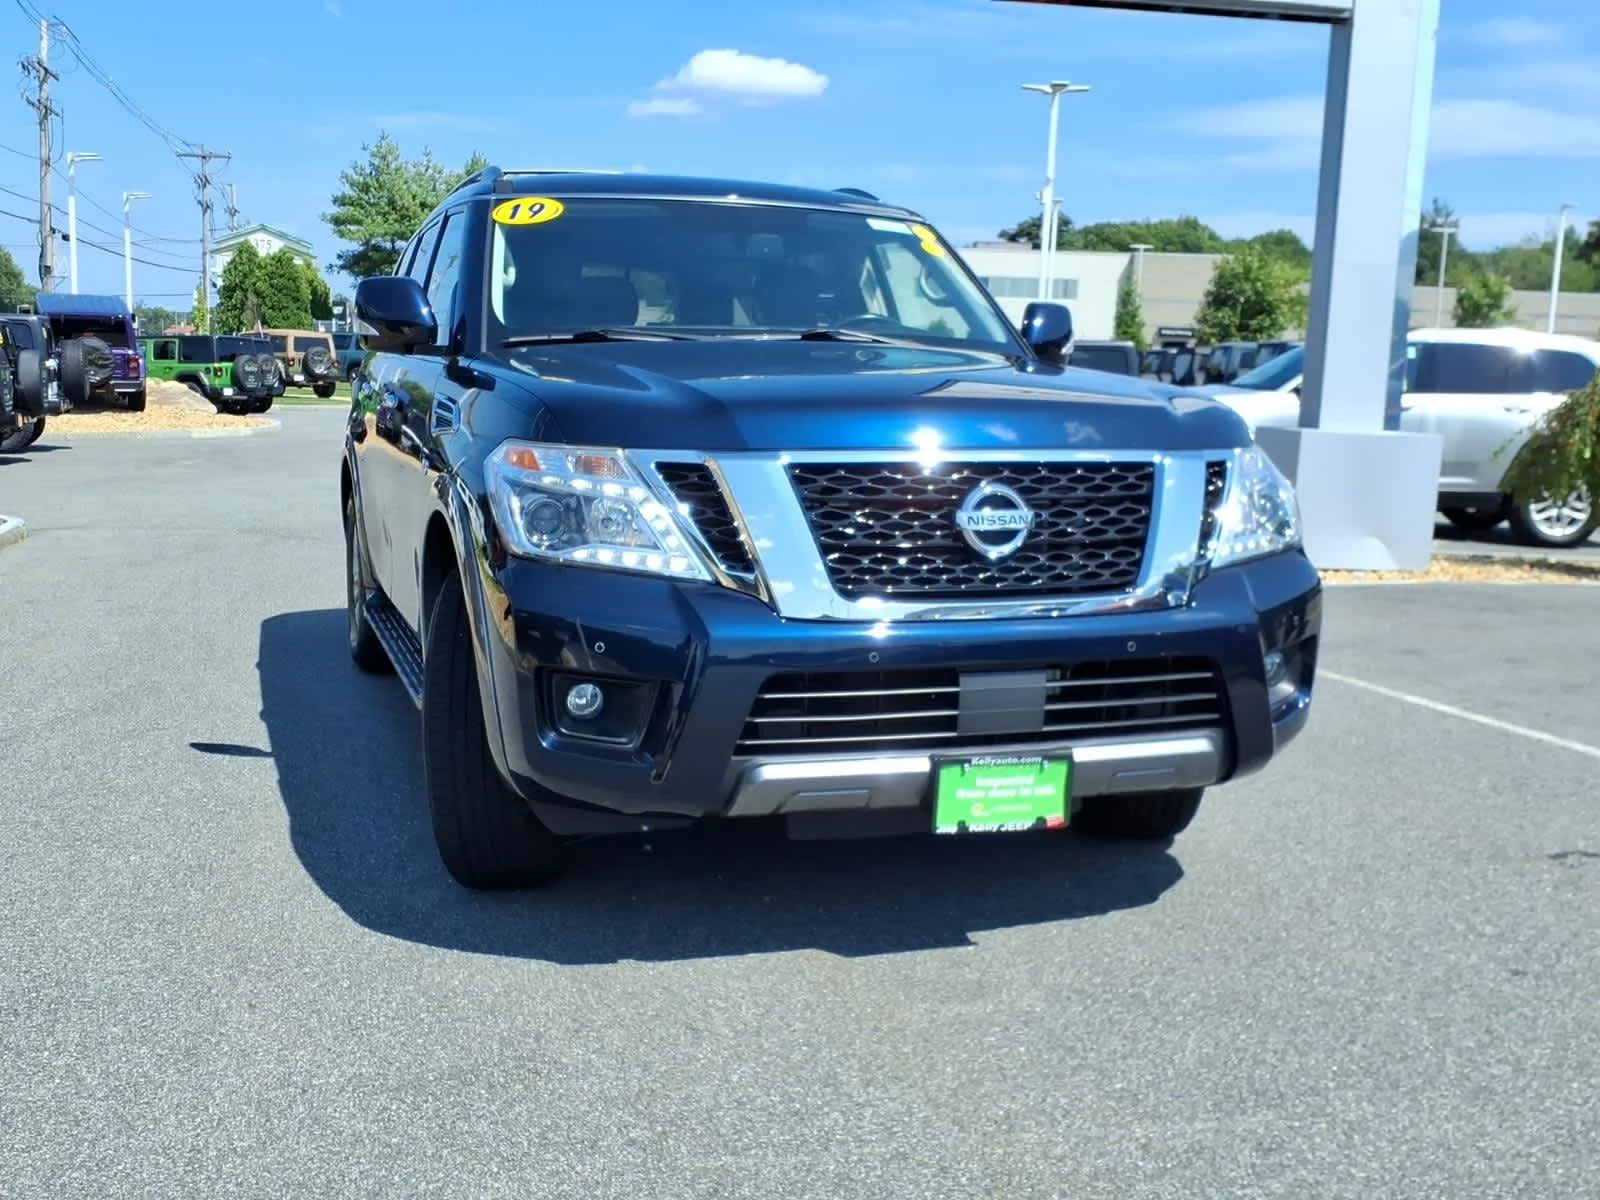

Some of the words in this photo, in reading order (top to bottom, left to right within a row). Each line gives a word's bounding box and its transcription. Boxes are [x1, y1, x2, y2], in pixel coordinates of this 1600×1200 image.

[508, 202, 546, 220] 19
[967, 514, 1030, 526] NISSAN
[971, 756, 1042, 767] Kellyauto.com
